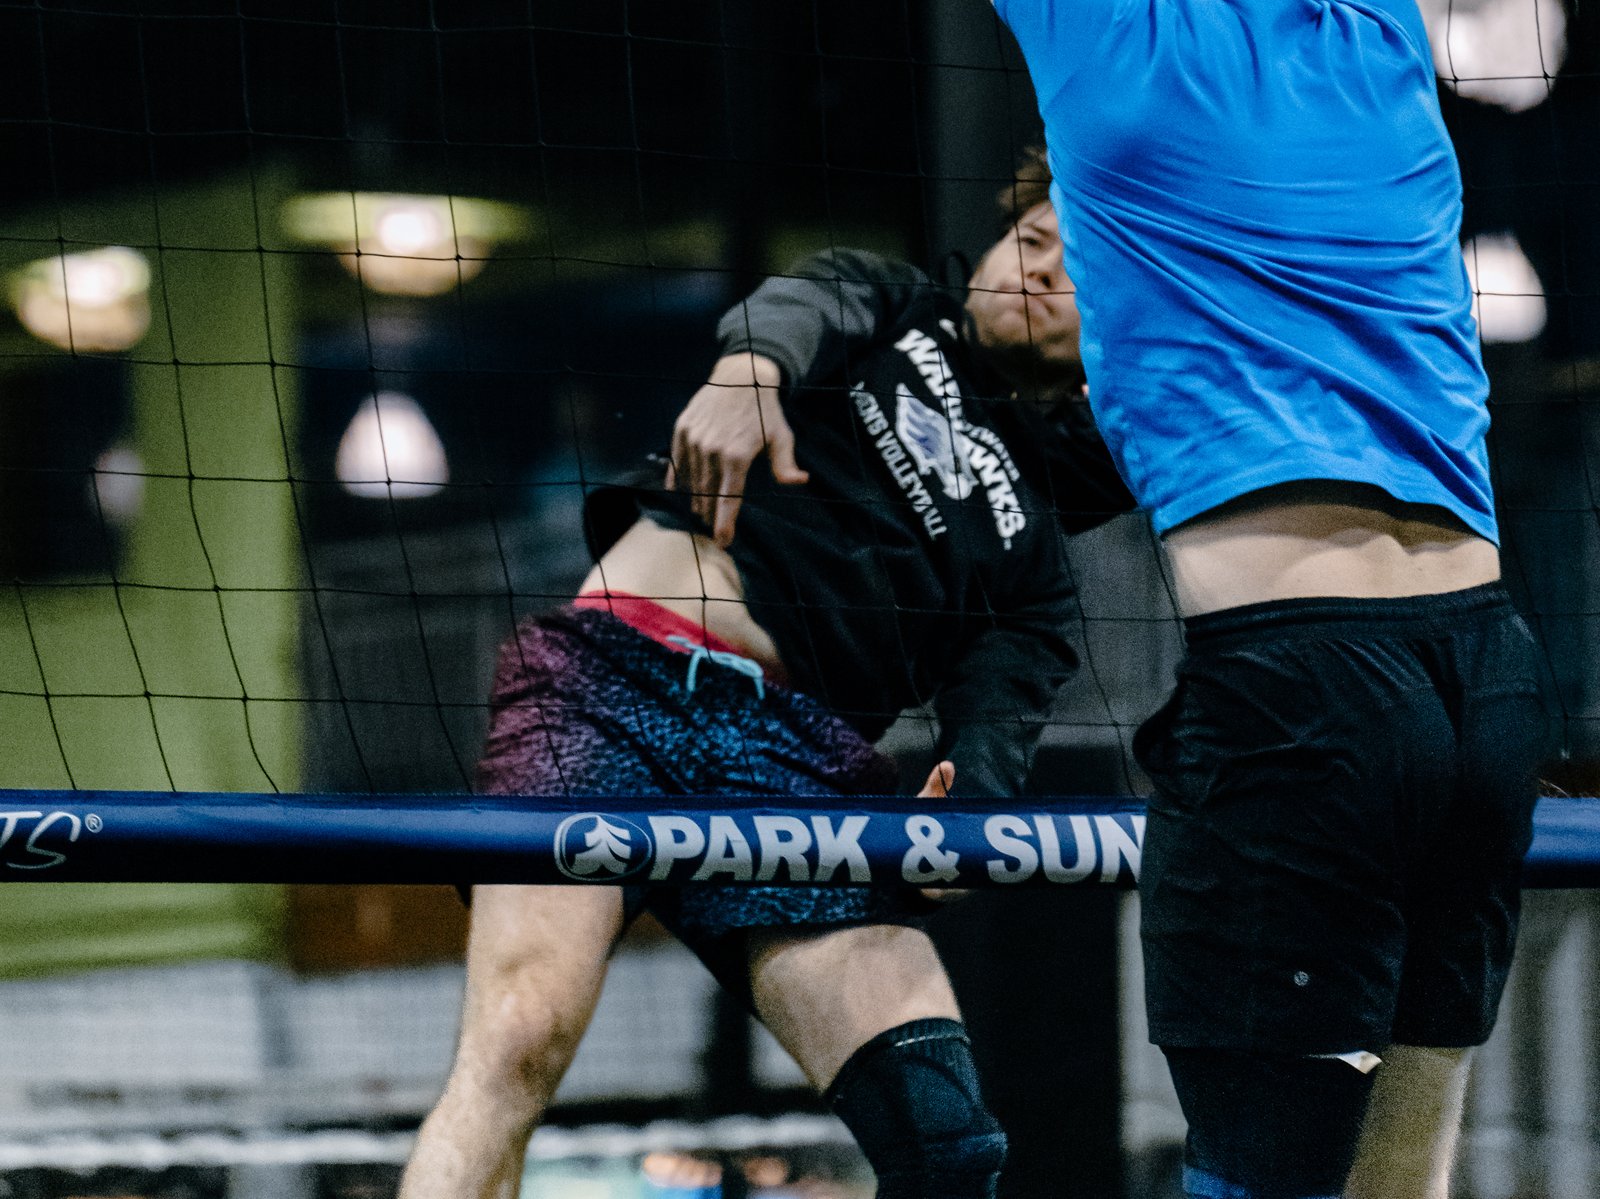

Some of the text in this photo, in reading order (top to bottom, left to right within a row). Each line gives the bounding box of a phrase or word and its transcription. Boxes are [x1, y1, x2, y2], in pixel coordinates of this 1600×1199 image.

[648, 814, 1147, 884] PARK & SUN
